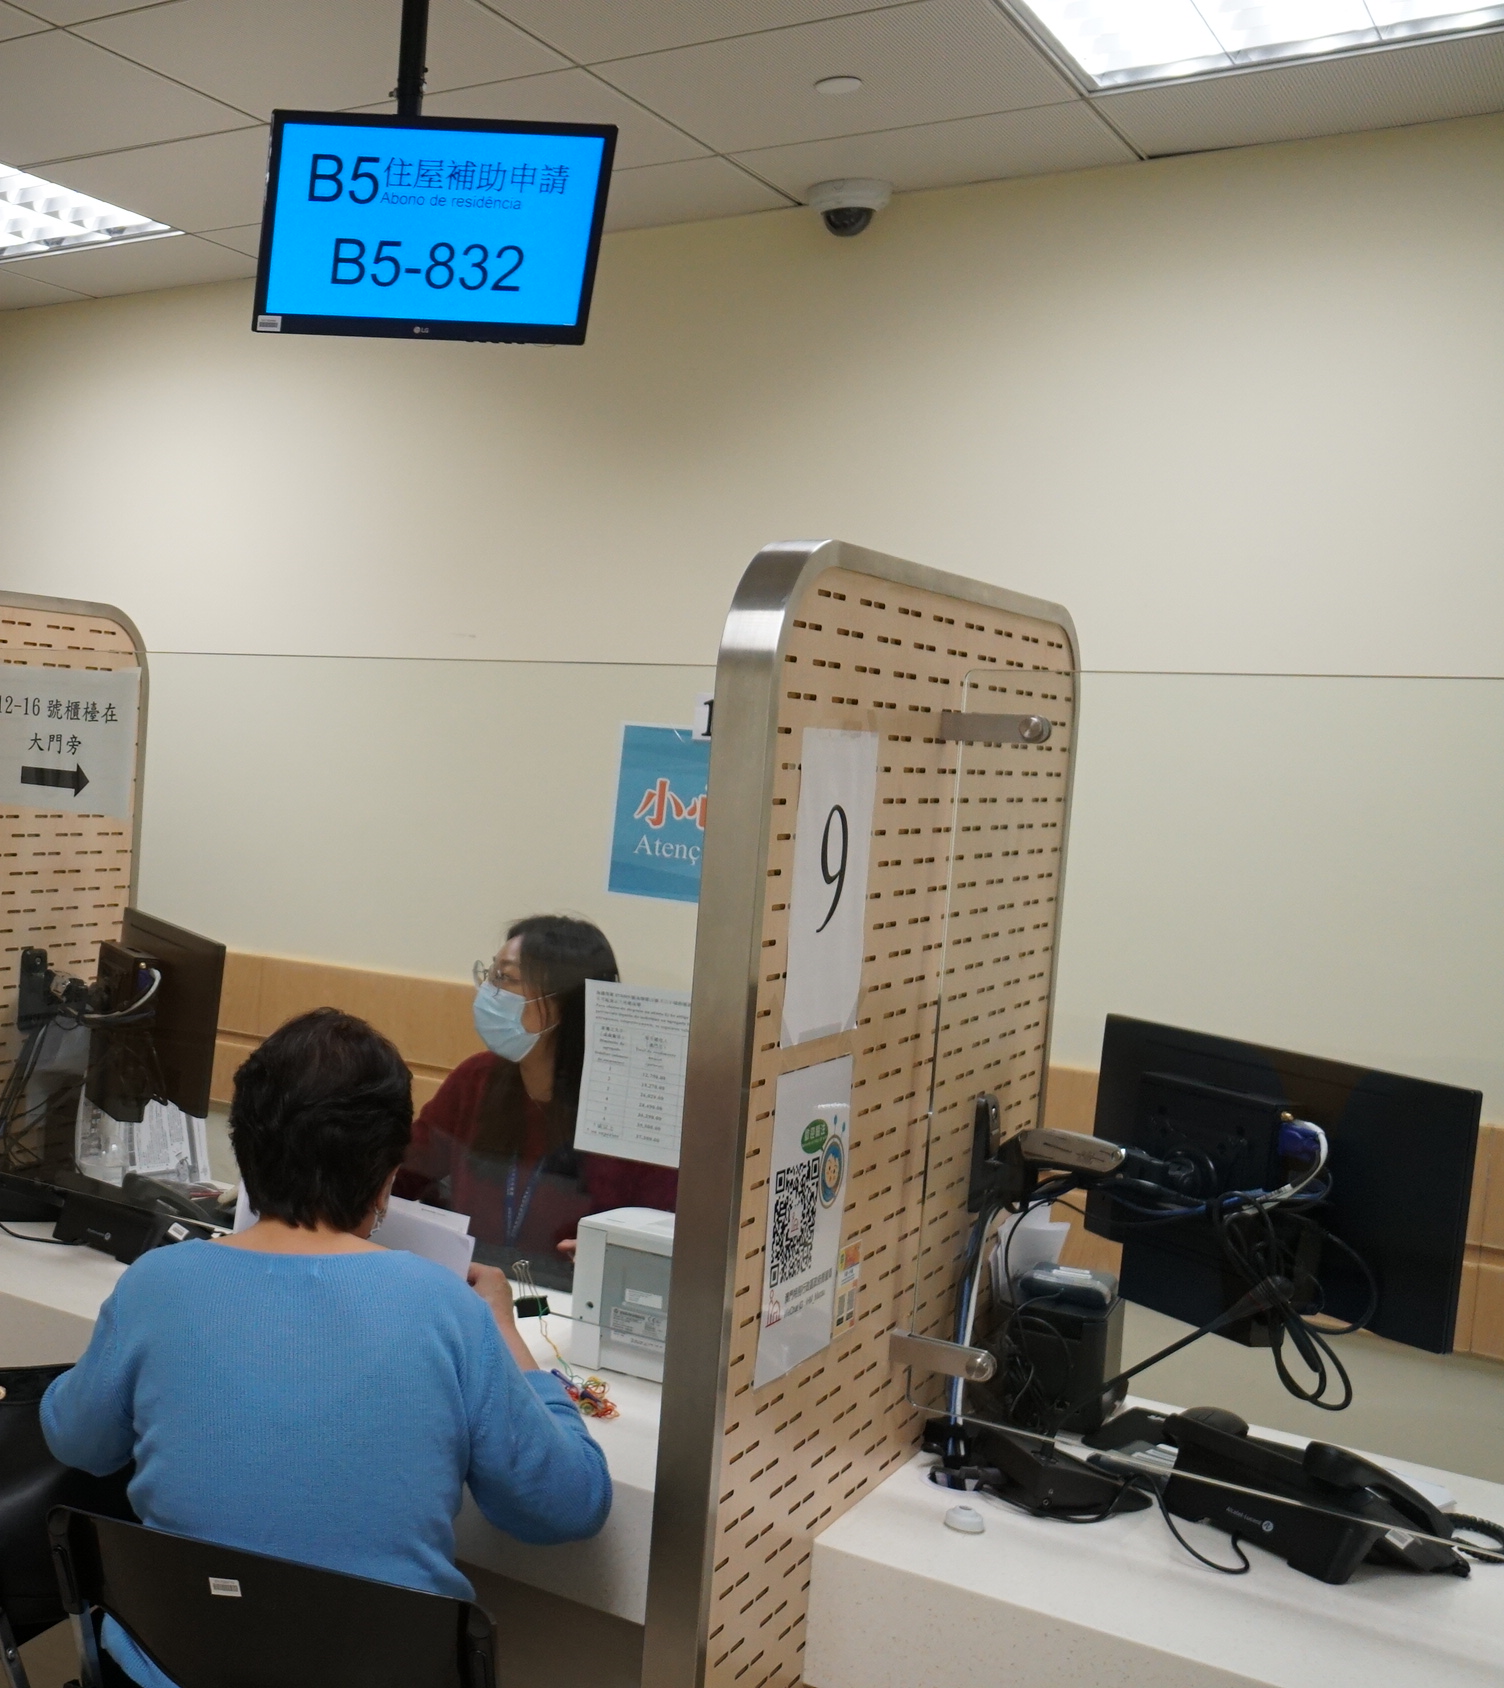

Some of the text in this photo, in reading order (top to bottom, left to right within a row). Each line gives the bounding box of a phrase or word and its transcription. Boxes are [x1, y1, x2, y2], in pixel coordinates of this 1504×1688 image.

[308, 153, 380, 204] B5
[383, 157, 570, 195] 住屋補助申請
[380, 192, 522, 211] Abono de residência
[330, 237, 524, 292] B5-832
[701, 699, 714, 737] 1
[28, 732, 82, 755] 大門旁
[634, 834, 701, 866] Atenç
[815, 804, 849, 933] 9
